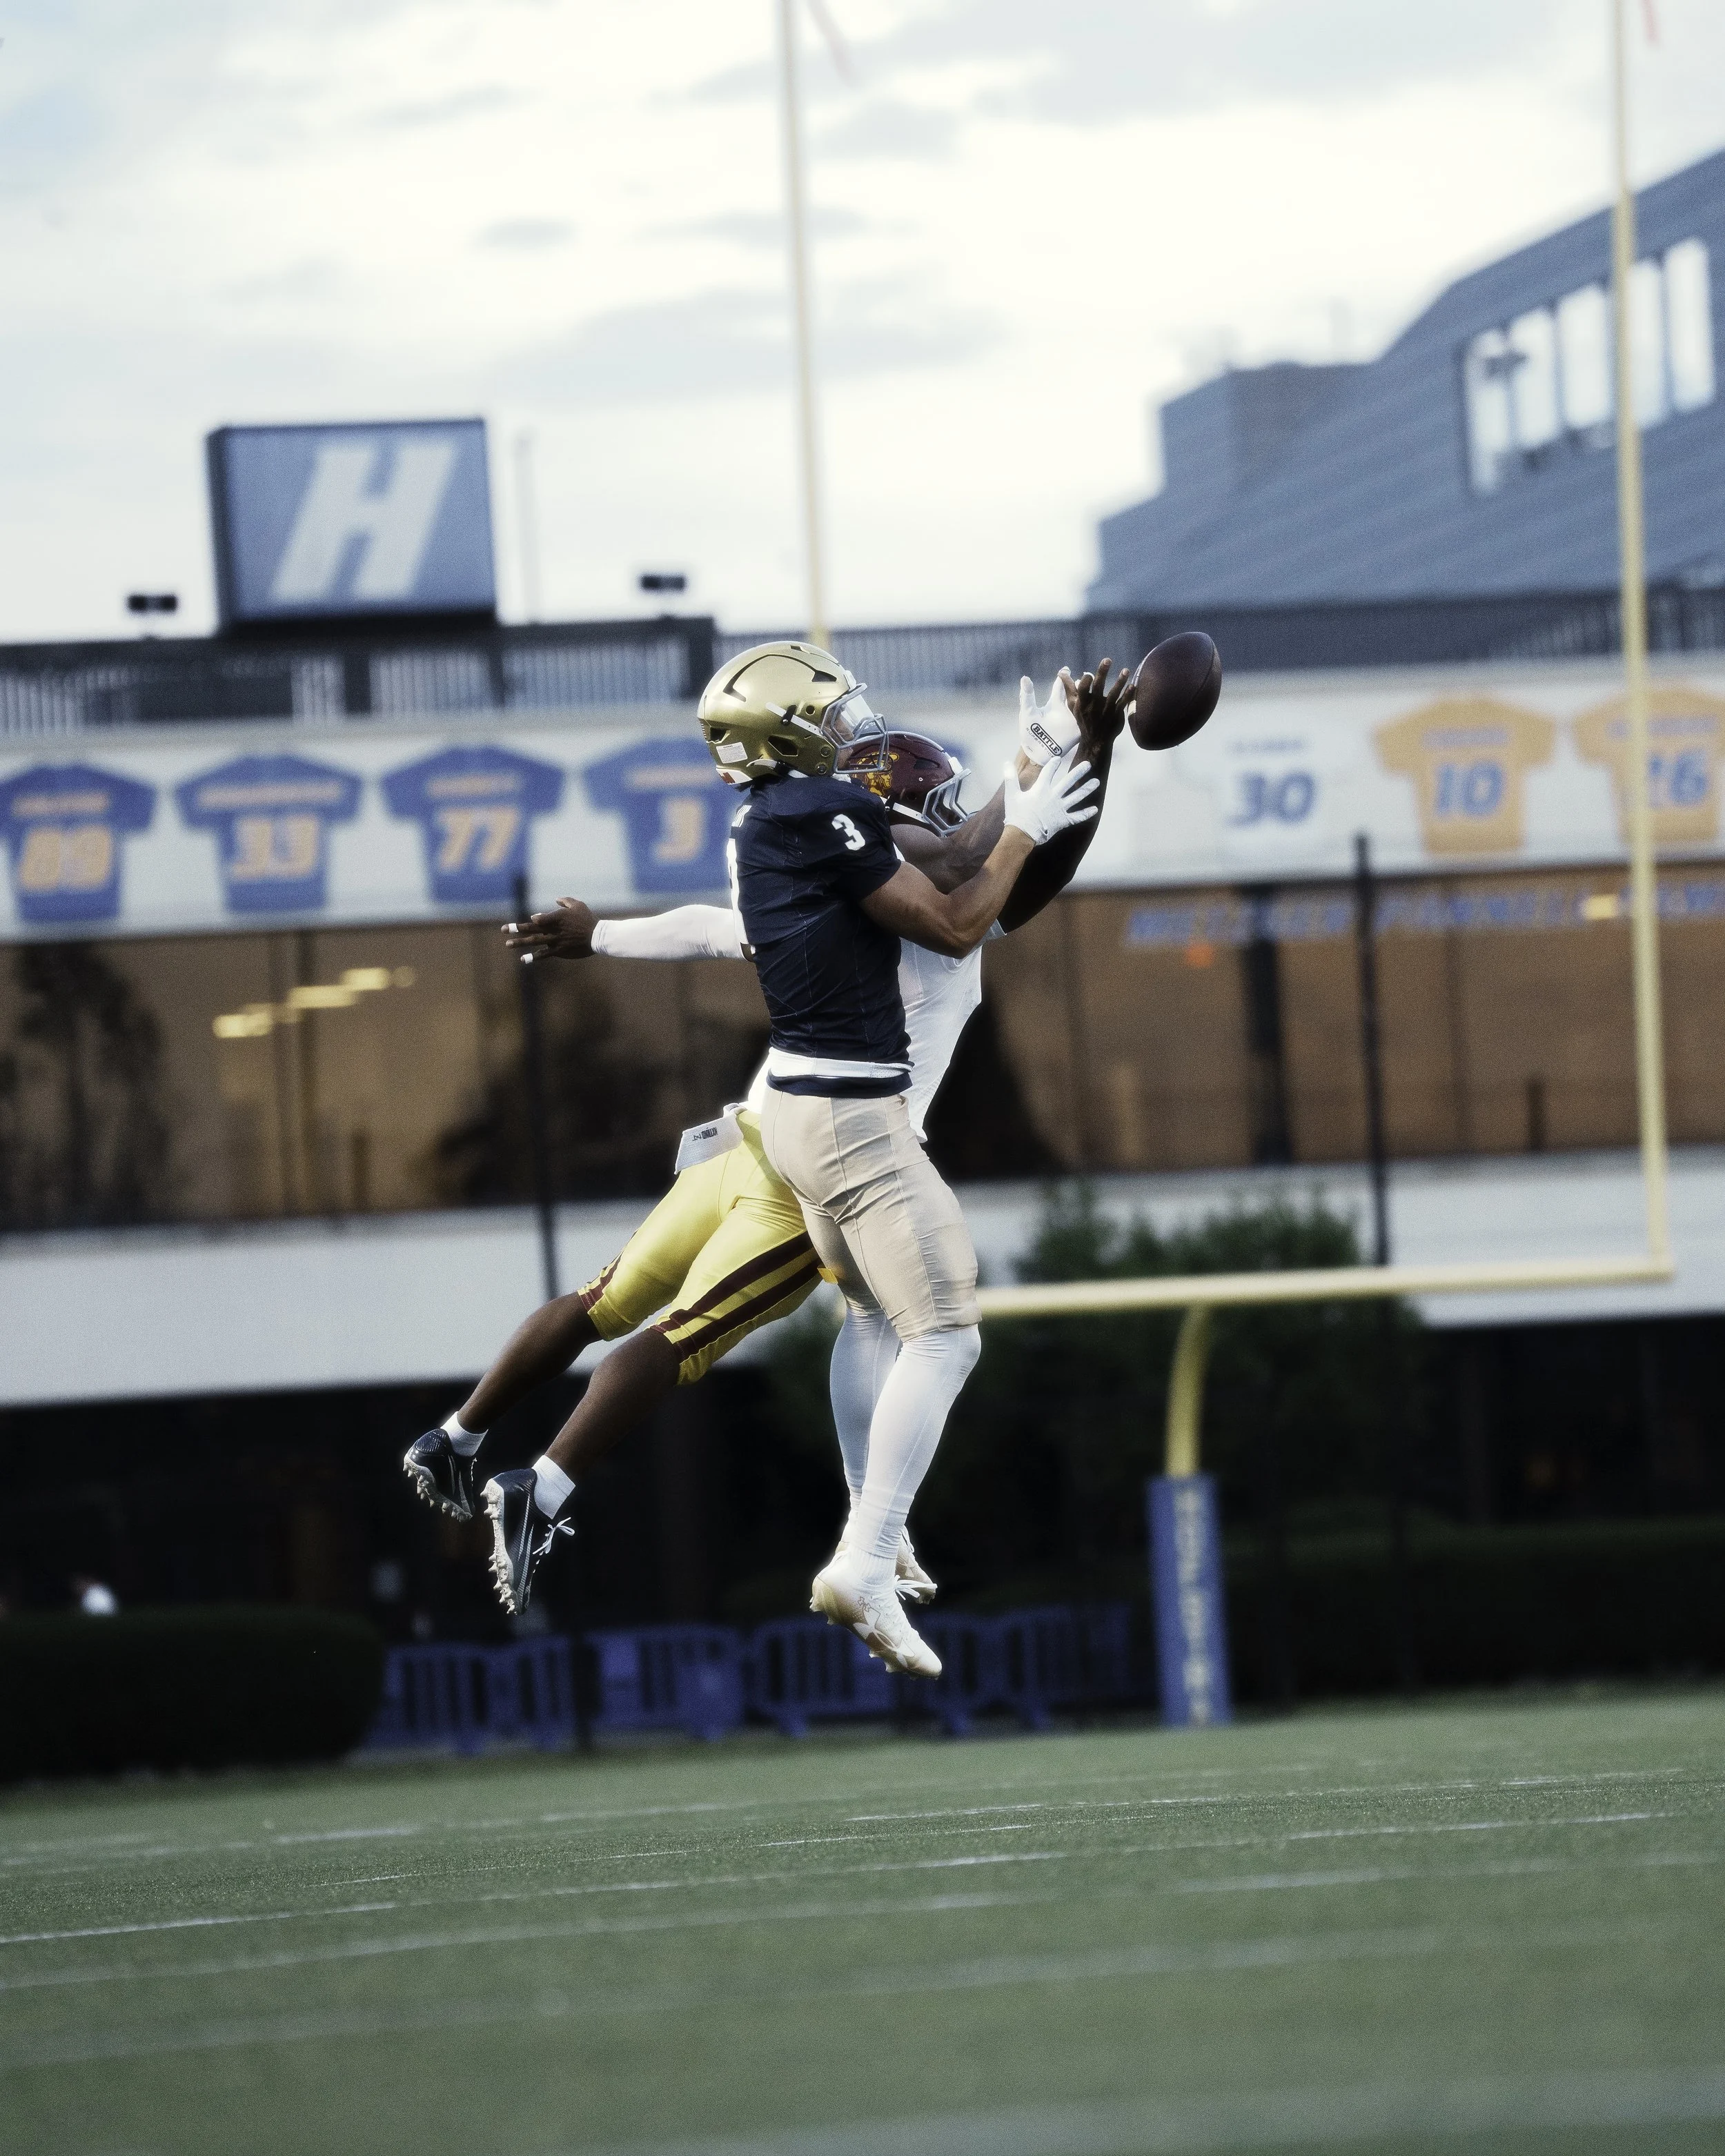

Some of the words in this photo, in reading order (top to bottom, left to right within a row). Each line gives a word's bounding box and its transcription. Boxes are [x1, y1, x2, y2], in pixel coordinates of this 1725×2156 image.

[273, 442, 459, 602] H
[1033, 725, 1060, 753] BATTLE
[1225, 769, 1317, 831] 30
[1434, 760, 1507, 820] 10
[436, 804, 520, 872] 77
[831, 813, 866, 851] 3
